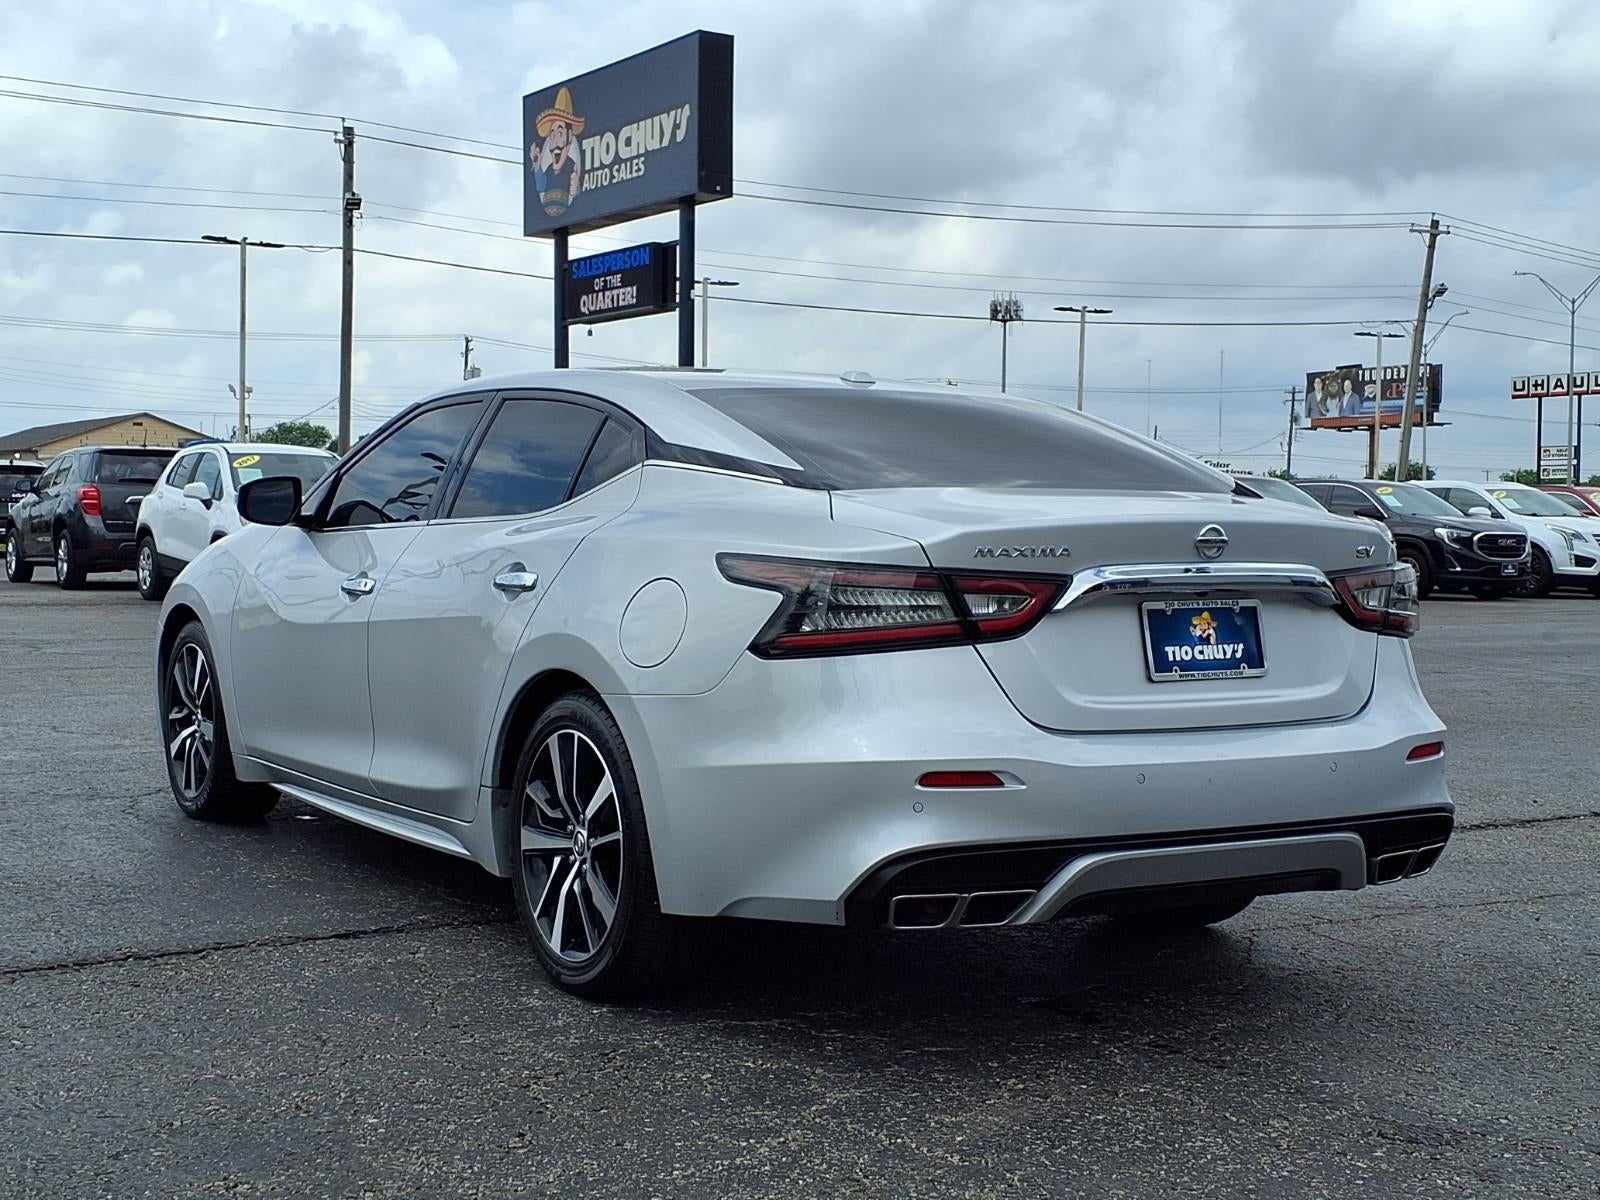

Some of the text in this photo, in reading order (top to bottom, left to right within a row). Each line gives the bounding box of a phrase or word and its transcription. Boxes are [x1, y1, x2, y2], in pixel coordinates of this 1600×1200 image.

[582, 103, 691, 170] TIO CHUY'S
[582, 157, 645, 191] AUTO SALES
[572, 246, 650, 279] SALESPERSON
[594, 274, 622, 290] OF THE
[580, 285, 637, 314] QUARTER!
[973, 545, 1071, 558] MAXIMA
[1355, 545, 1376, 559] SV
[1165, 643, 1245, 661] TIO CHUY'S
